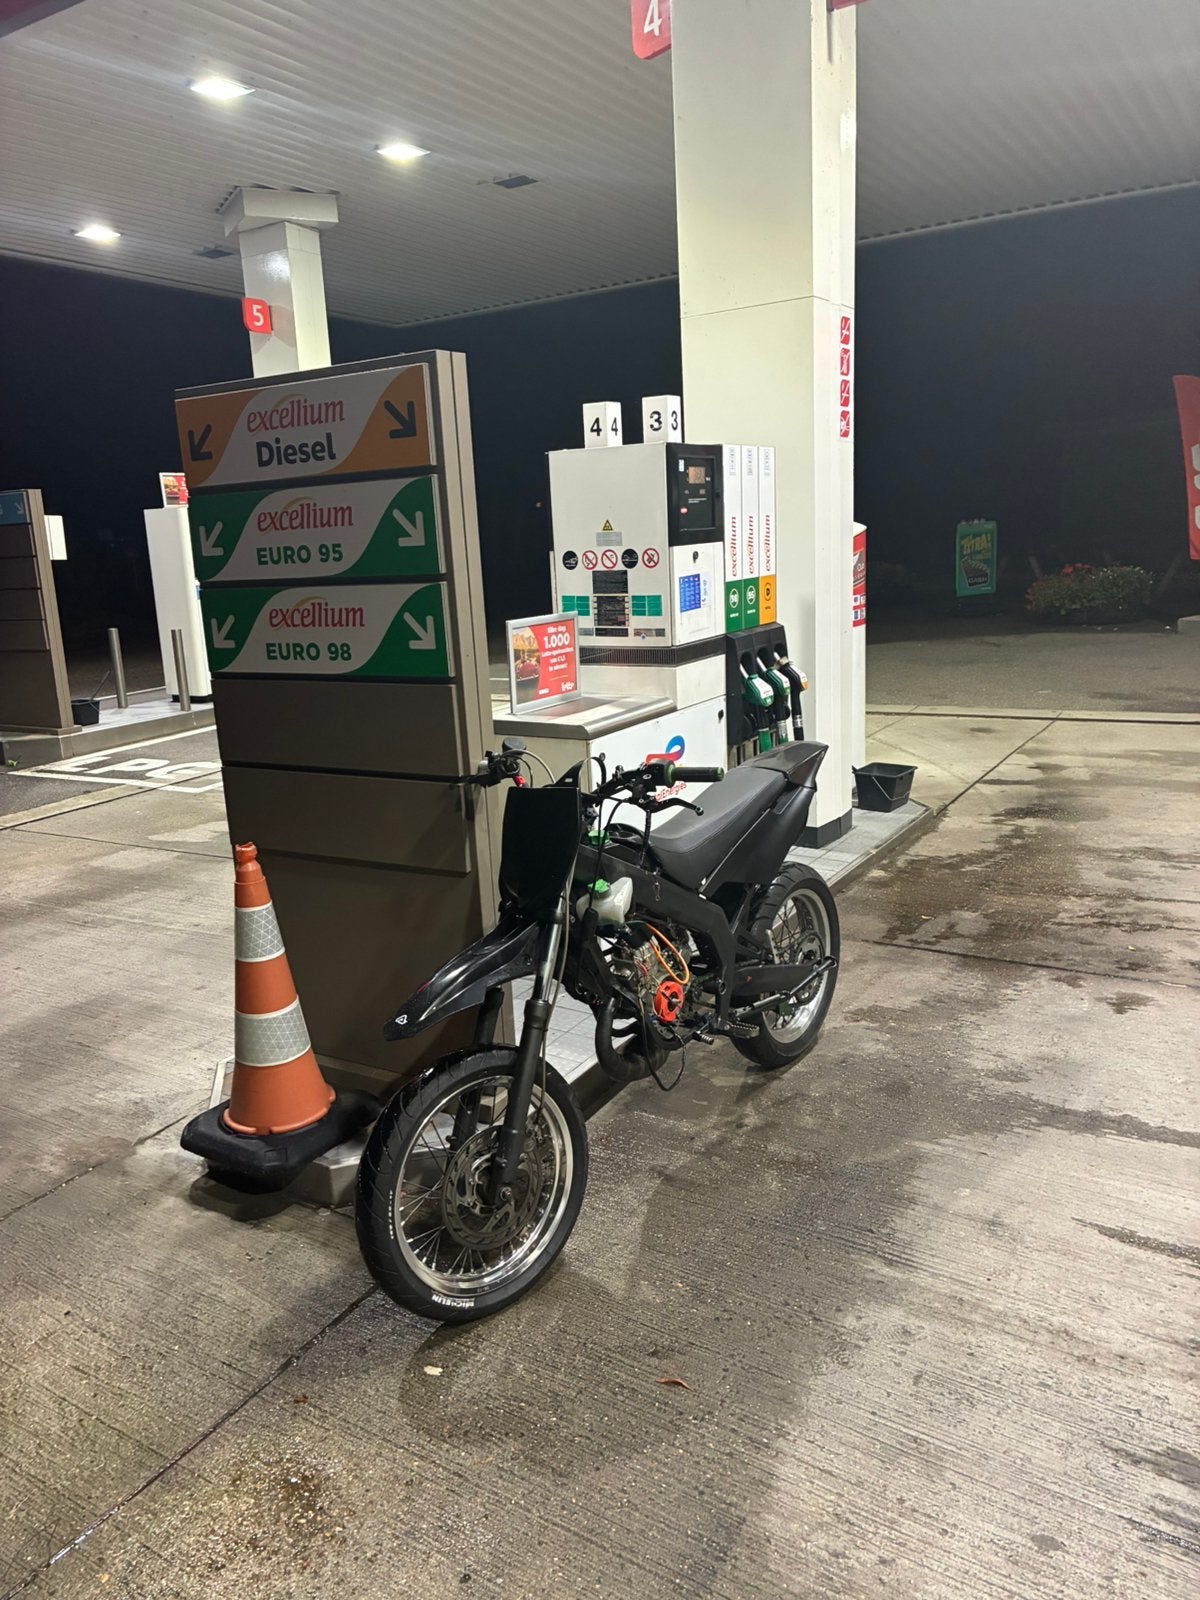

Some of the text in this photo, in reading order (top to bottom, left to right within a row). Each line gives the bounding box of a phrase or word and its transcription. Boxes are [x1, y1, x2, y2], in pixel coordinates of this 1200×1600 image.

[643, 0, 662, 36] 4
[252, 304, 264, 327] 5
[247, 398, 345, 433] excellium
[590, 416, 602, 437] 4
[611, 416, 619, 436] 4
[649, 410, 663, 432] 3
[671, 410, 679, 431] 3
[256, 432, 336, 468] Diesel
[257, 502, 353, 535] excellium
[256, 543, 343, 566] EURO 95
[268, 602, 365, 630] excellium
[266, 642, 352, 661] EURO 98
[543, 632, 570, 649] 1.000
[33, 756, 222, 779] LPG
[431, 1293, 475, 1309] MICHELIN
